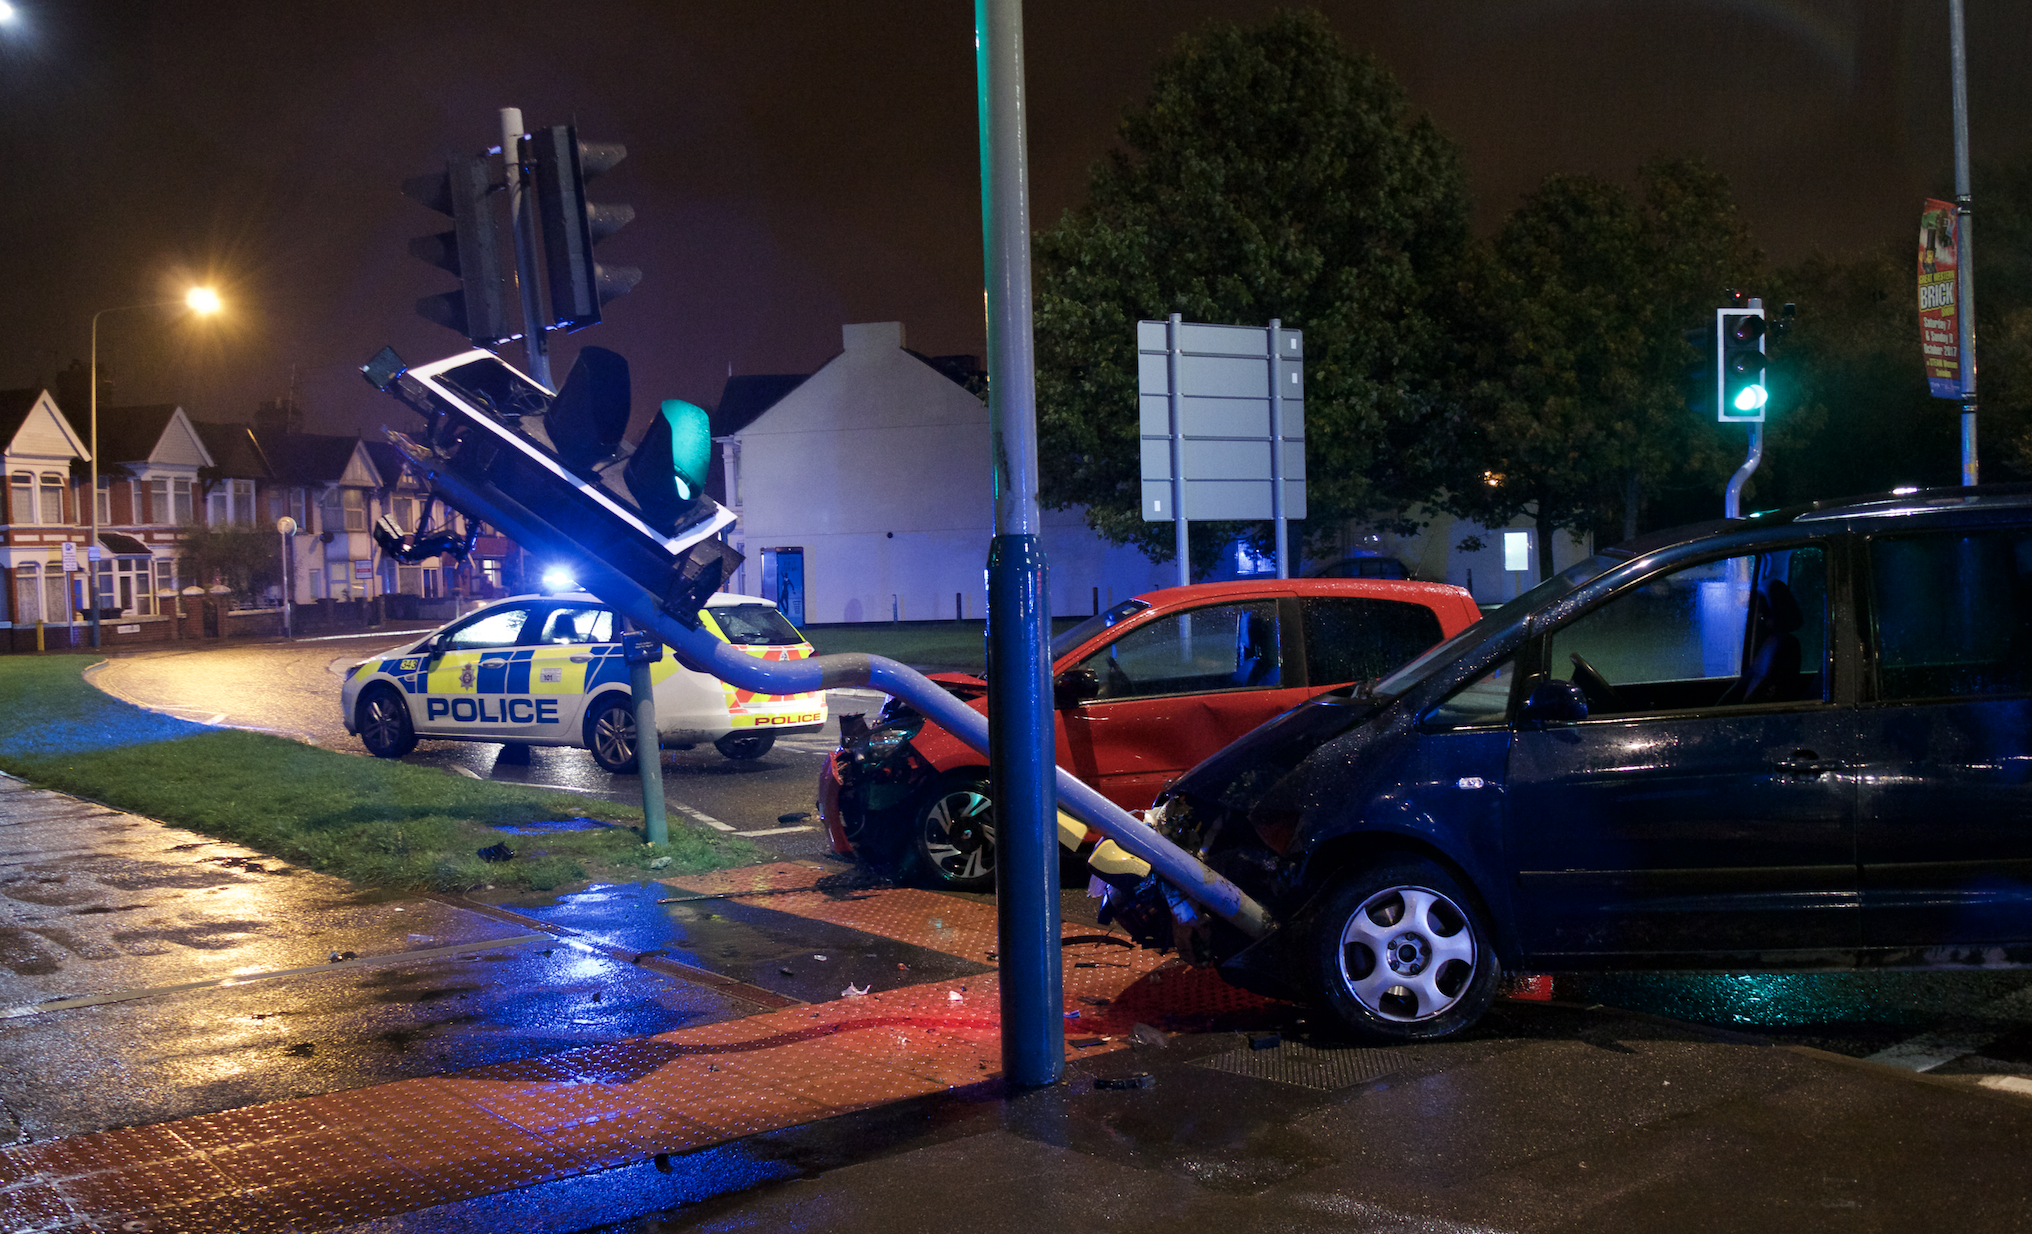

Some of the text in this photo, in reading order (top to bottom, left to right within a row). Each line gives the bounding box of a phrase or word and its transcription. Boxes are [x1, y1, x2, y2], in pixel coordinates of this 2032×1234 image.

[1920, 281, 1954, 310] BRICK
[1944, 345, 1958, 357] 2017
[402, 659, 418, 669] 343
[427, 698, 559, 724] POLICE
[755, 713, 821, 727] POLICE
